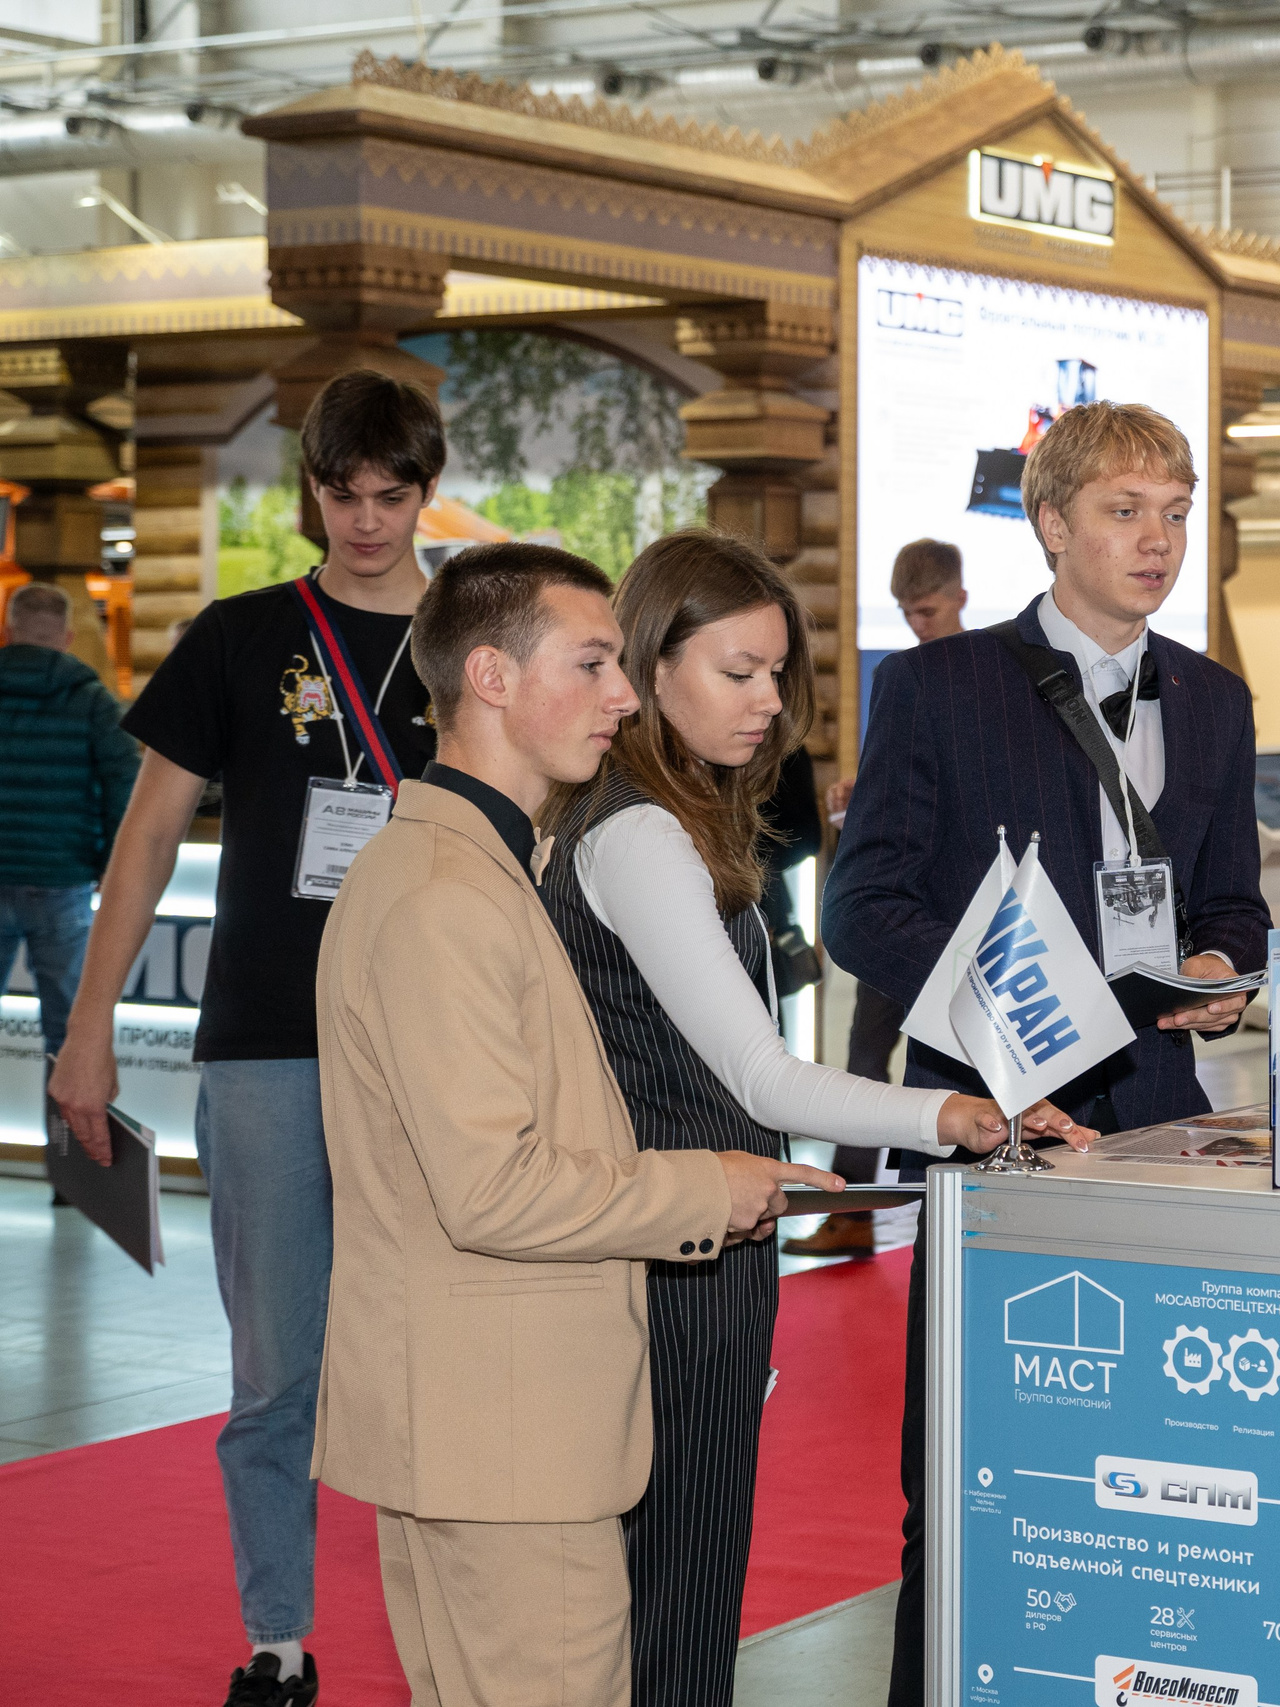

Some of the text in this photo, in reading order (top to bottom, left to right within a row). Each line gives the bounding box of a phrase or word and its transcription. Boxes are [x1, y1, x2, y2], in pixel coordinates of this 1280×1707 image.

[980, 154, 1114, 236] UMG
[877, 289, 963, 337] UMG
[1202, 1281, 1242, 1296] Группа
[1014, 1353, 1118, 1394] МАСТ
[1014, 1388, 1111, 1410] Группа компаний
[1164, 1417, 1219, 1431] Производство
[1232, 1425, 1275, 1437] Релизация
[1160, 1476, 1252, 1511] СПМ
[1013, 1517, 1254, 1566] Производство и ремонт
[1012, 1549, 1260, 1596] подъемной спецтехники
[1026, 1588, 1051, 1609] 50
[1025, 1609, 1062, 1623] дилеров
[1025, 1621, 1047, 1632] в РФ
[1150, 1605, 1175, 1627] 28
[1150, 1628, 1198, 1642] сервисных
[1150, 1640, 1187, 1653] центров
[976, 1686, 999, 1695] Москва
[1133, 1670, 1240, 1706] ВолгоИнвест
[969, 1694, 1001, 1705] volgo-in.ru
